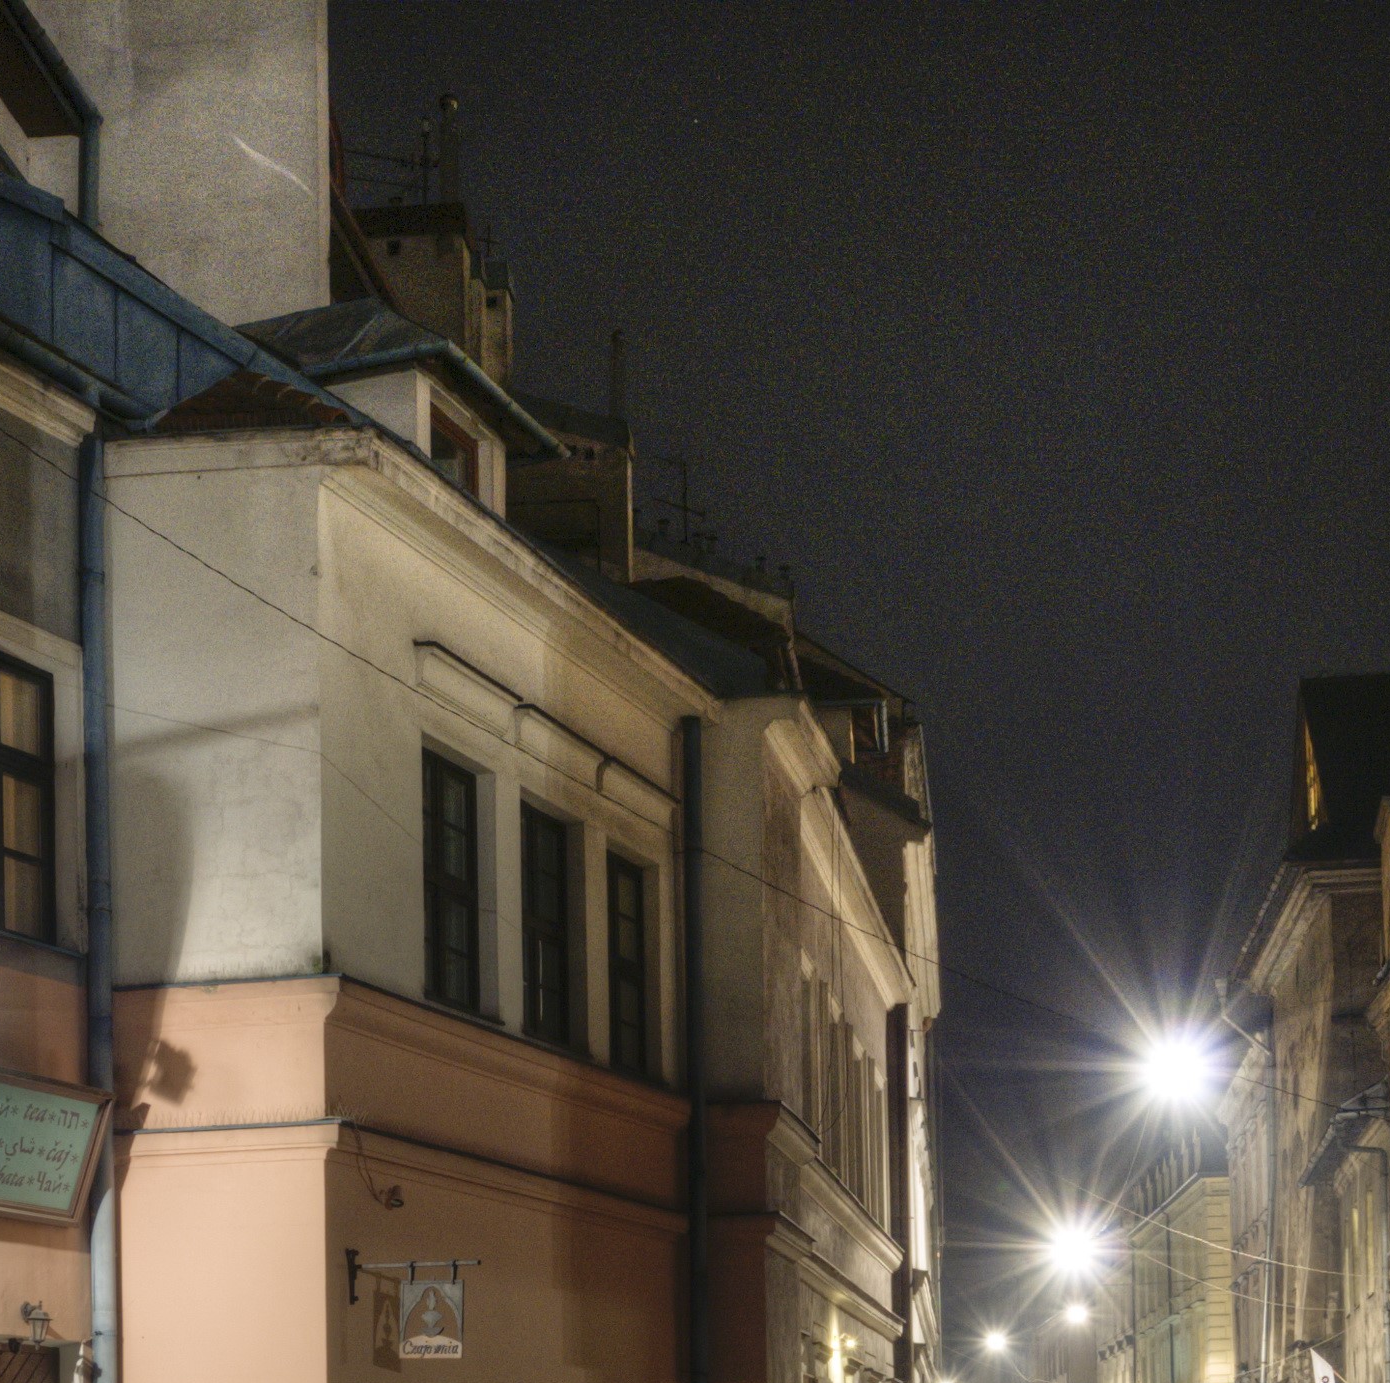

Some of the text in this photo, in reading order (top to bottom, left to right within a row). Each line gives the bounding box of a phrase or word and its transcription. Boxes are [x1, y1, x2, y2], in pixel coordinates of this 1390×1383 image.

[23, 1103, 48, 1122] tea
[46, 1140, 72, 1171] čaj
[37, 1171, 64, 1194] Чай
[402, 1340, 459, 1358] Czajownia
